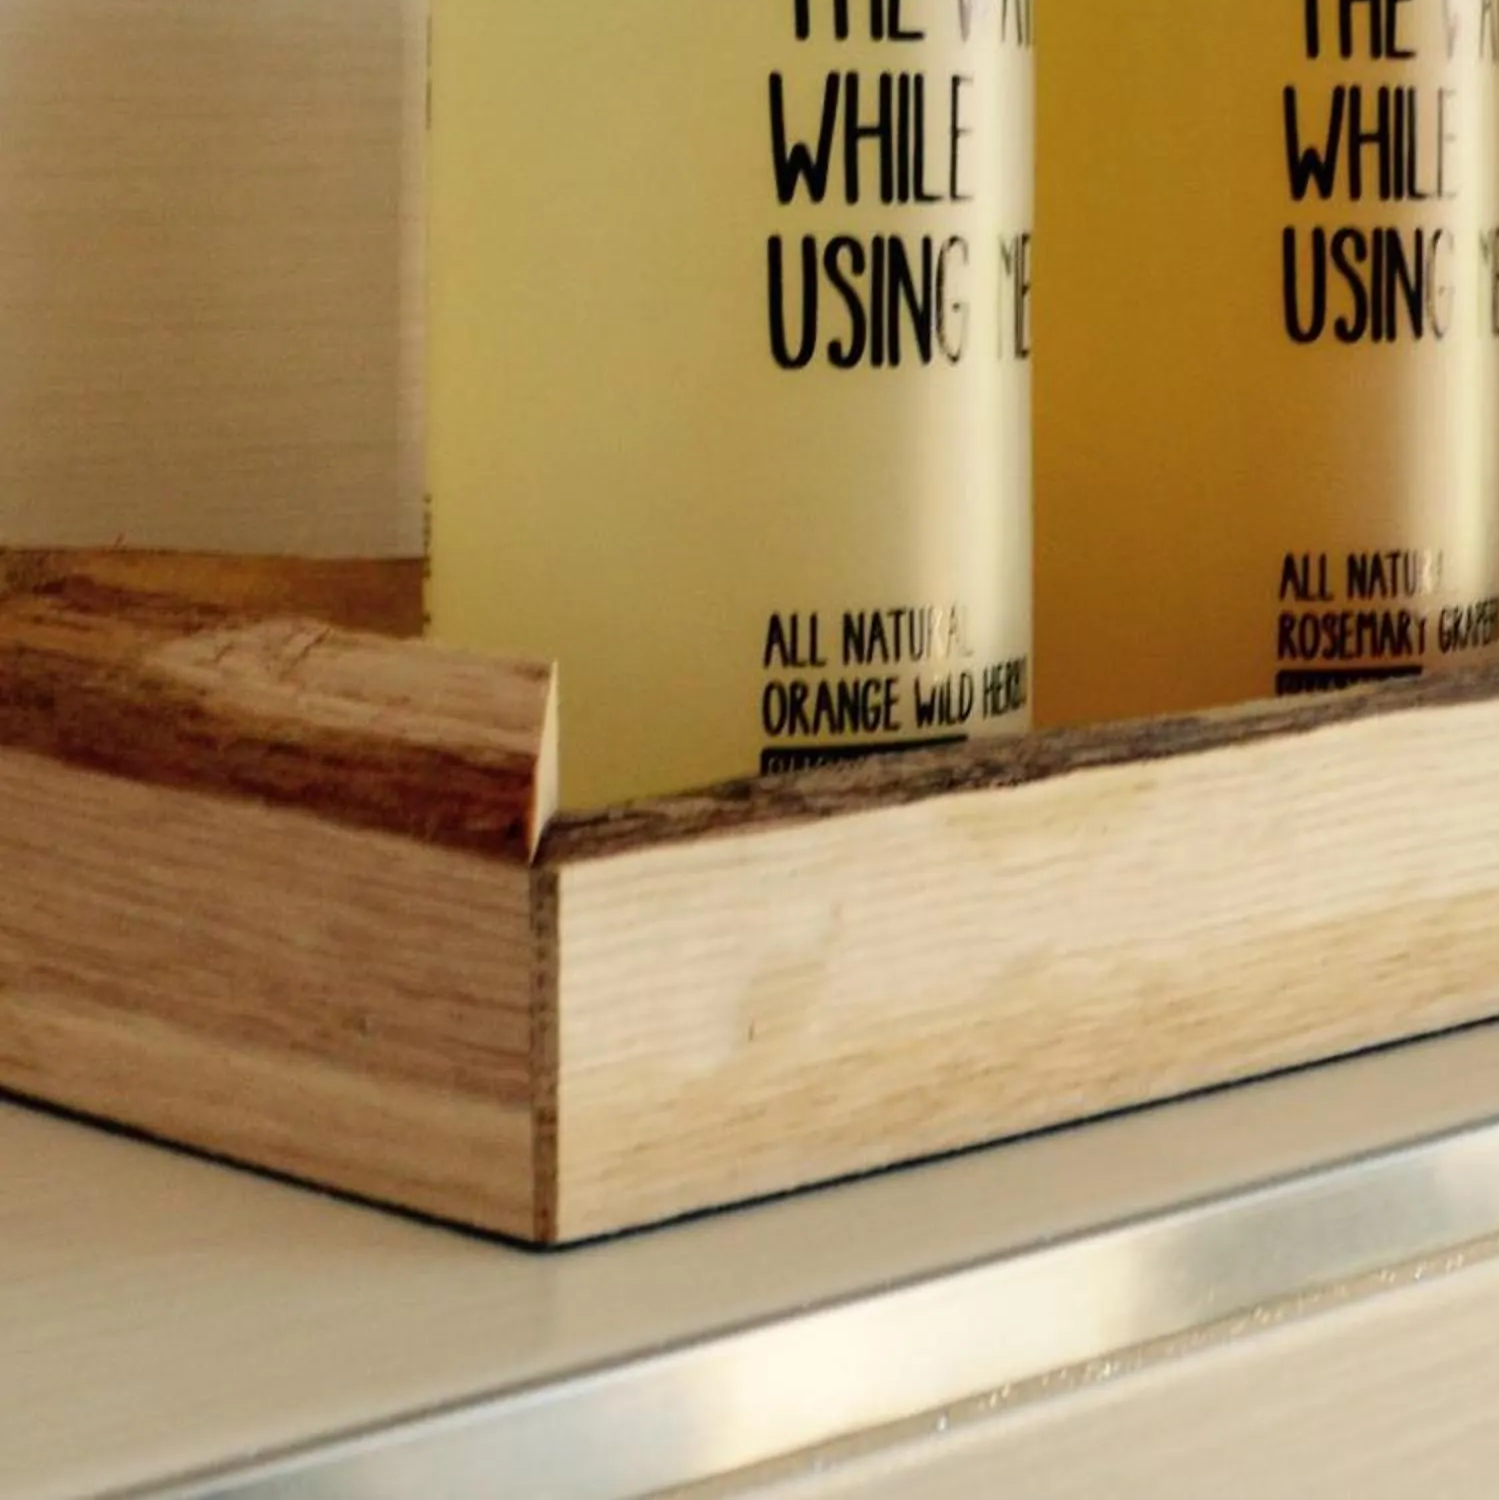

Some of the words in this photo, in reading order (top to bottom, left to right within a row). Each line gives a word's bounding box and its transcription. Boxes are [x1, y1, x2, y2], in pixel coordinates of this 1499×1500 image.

[768, 70, 973, 205] WHILE
[1283, 84, 1457, 201] WHILE
[767, 233, 970, 370] USING
[1282, 226, 1456, 344] USING
[1278, 552, 1335, 602] ALL
[1346, 550, 1443, 599] NATU
[763, 610, 827, 669] ALL
[1277, 607, 1427, 661] ROSEMARY
[761, 675, 901, 738] ORANGE
[913, 670, 975, 729] WILD
